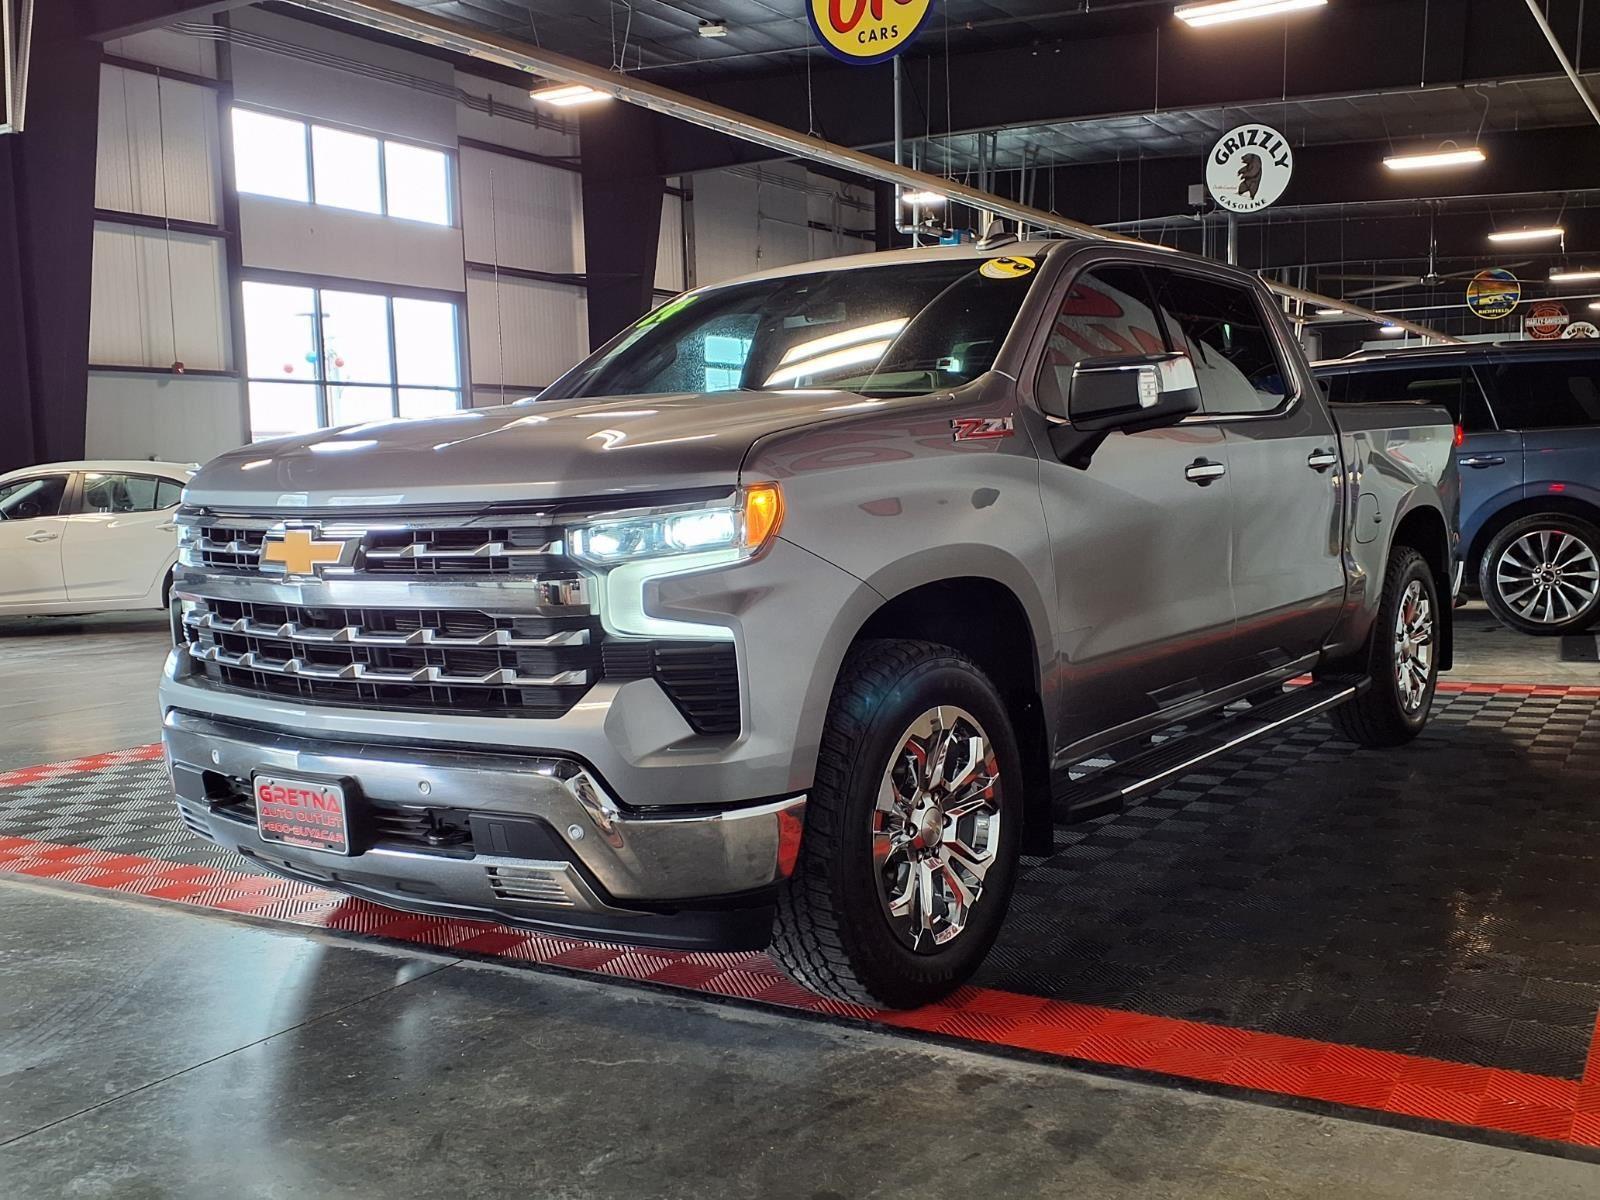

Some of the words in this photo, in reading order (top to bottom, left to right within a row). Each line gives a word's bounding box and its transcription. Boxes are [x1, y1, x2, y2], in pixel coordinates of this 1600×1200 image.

[858, 25, 898, 43] CARS
[1215, 129, 1289, 168] GRIZZLY
[1219, 195, 1266, 209] GASOLINE
[952, 417, 1014, 441] Z71
[258, 785, 340, 813] GRETNA
[262, 806, 294, 820] AUTO
[296, 810, 343, 828] OUTLET
[260, 821, 344, 843] 1-800-BUYACAR
